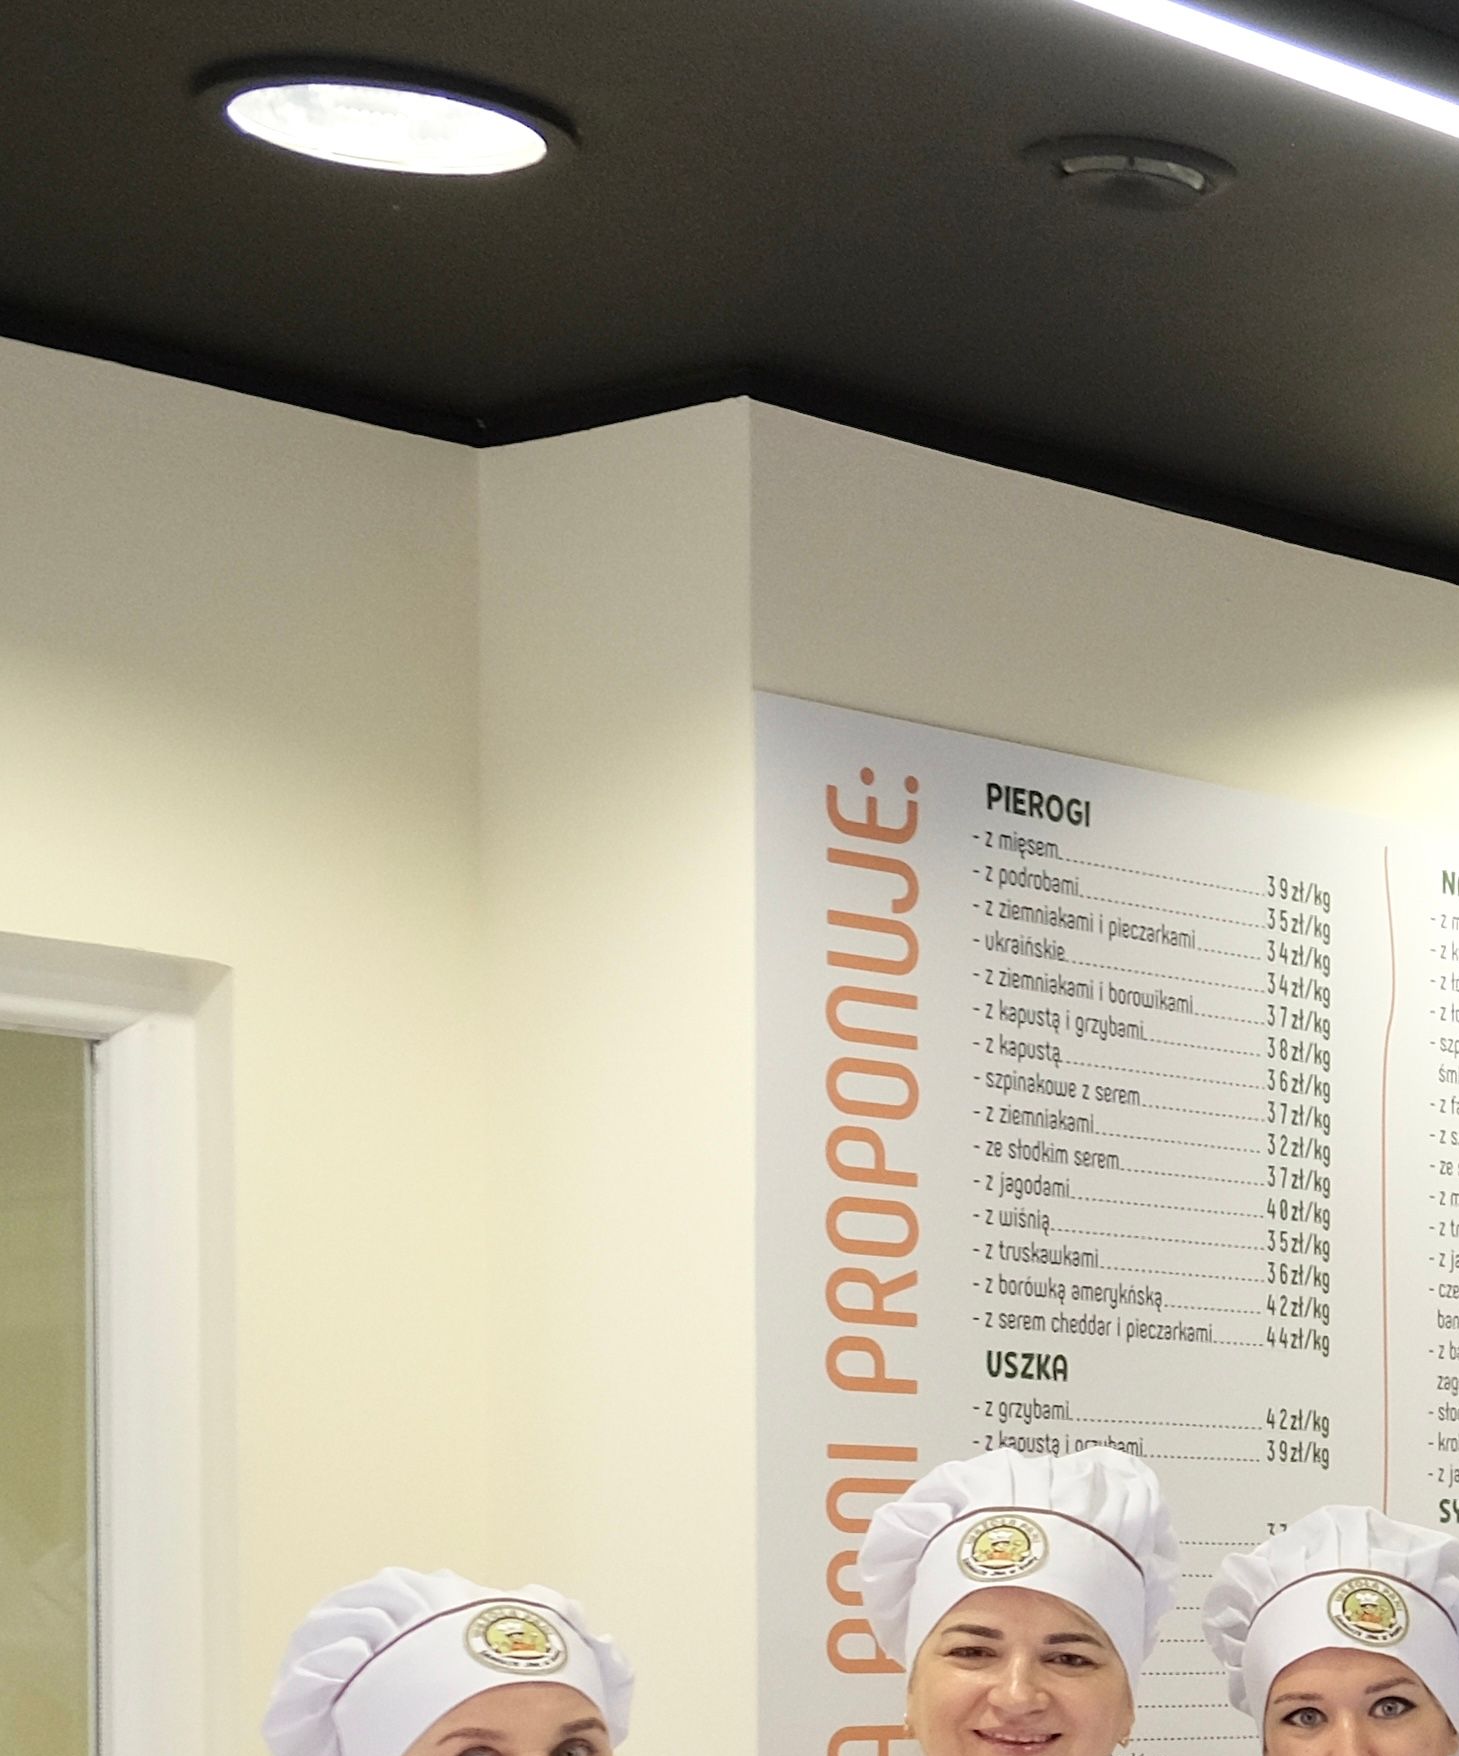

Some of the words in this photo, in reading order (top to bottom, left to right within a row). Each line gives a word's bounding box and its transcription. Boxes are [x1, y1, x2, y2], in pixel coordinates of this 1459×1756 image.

[986, 783, 1090, 826] PIEROGI
[999, 832, 1060, 859] mięsem
[998, 867, 1080, 896] podrobami
[998, 900, 1093, 931] ziemniakami
[1108, 918, 1195, 948] pieczarkami
[985, 930, 1067, 962] ukraińskie
[998, 968, 1093, 999] ziemniakami
[1108, 982, 1193, 1013] borowikami
[999, 999, 1060, 1033] kapustą
[1075, 1015, 1145, 1041] grzybami
[999, 1034, 1062, 1068] kapustą
[826, 766, 919, 1394] PROPONUJE:
[985, 1071, 1077, 1098] szpinakowe
[1094, 1085, 1140, 1105] serem
[999, 1105, 1094, 1133] ziemniakami
[985, 1140, 1002, 1158] ze
[1007, 1138, 1068, 1164] słodkim
[1073, 1150, 1121, 1169] serem
[1439, 1160, 1453, 1176] ze
[998, 1172, 1069, 1199] jagodami
[999, 1207, 1052, 1236] wiśnią
[998, 1241, 1098, 1267] truskawkami
[998, 1273, 1066, 1305] borówką
[998, 1312, 1045, 1331] serem
[1050, 1312, 1112, 1336] cheddar
[1126, 1319, 1212, 1342] pieczarkami
[986, 1350, 1068, 1381] USZKA
[998, 1398, 1071, 1425] grzybami
